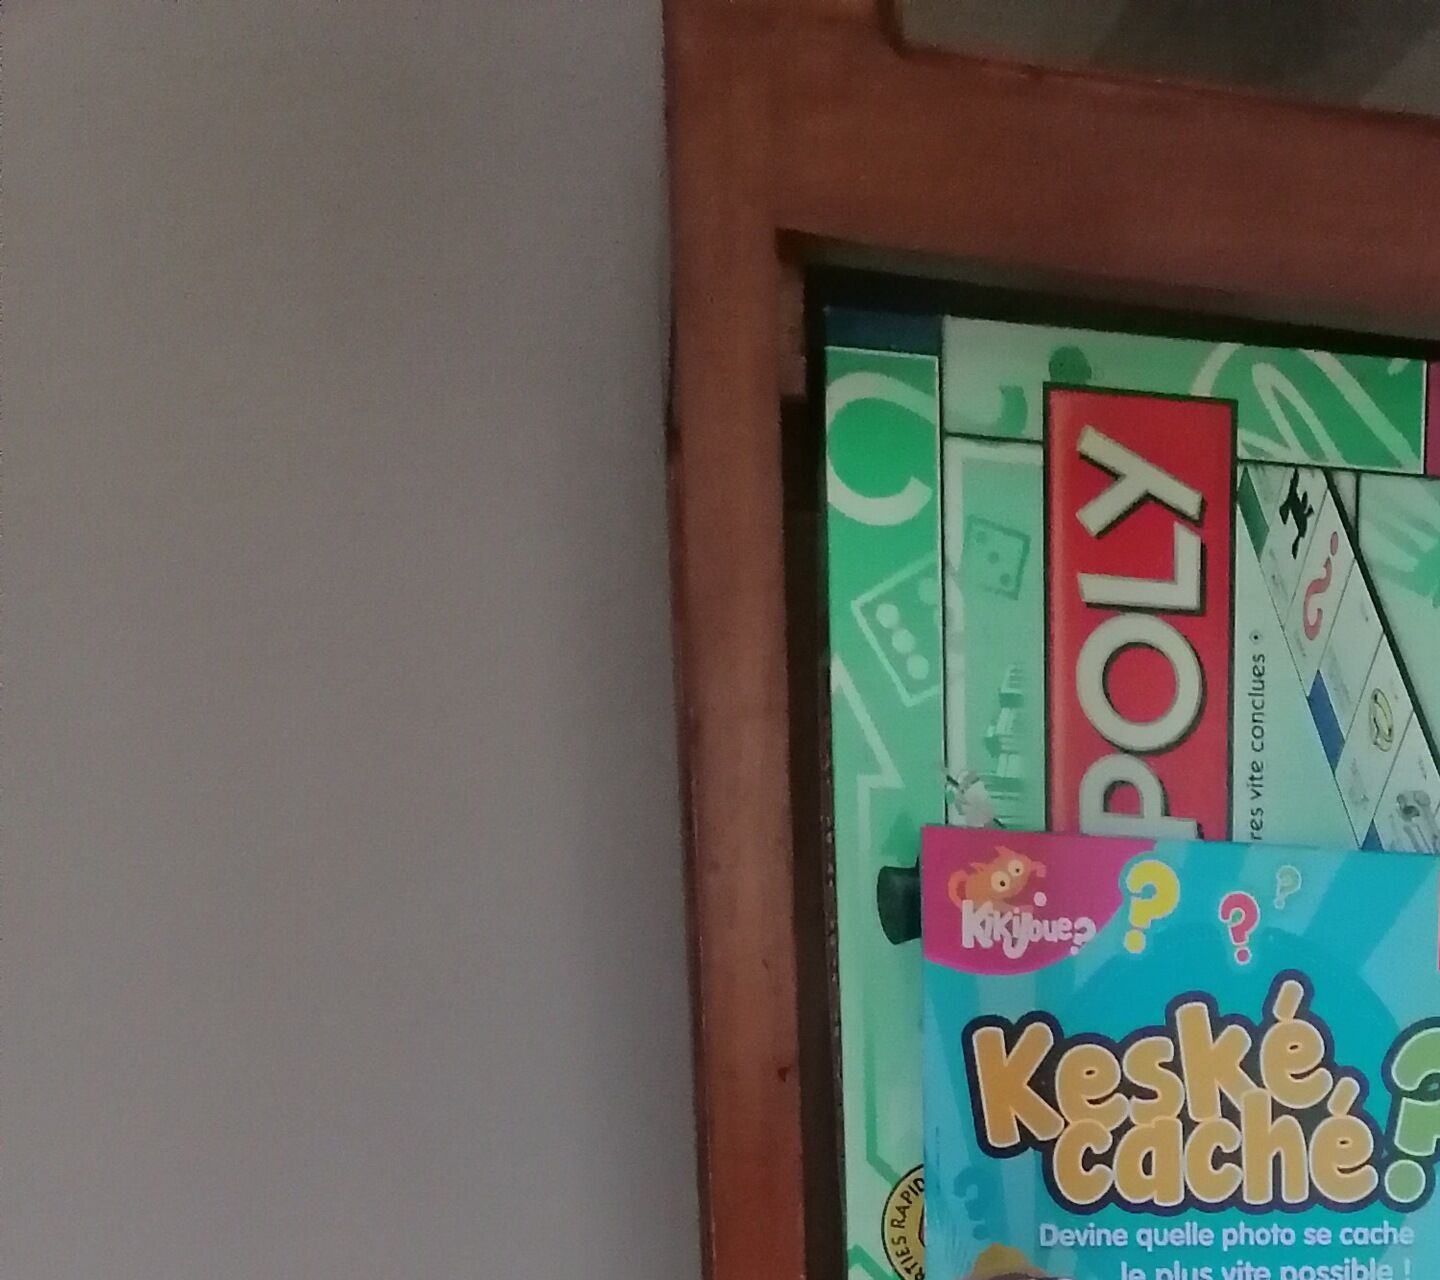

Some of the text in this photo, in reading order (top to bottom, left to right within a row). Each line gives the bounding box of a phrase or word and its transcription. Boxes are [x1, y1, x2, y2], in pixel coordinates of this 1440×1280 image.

[1248, 652, 1266, 743] conclues
[1247, 757, 1266, 802] vite
[972, 979, 1333, 1148] Keské
[1039, 1220, 1415, 1252] Devine quelle photo se cache
